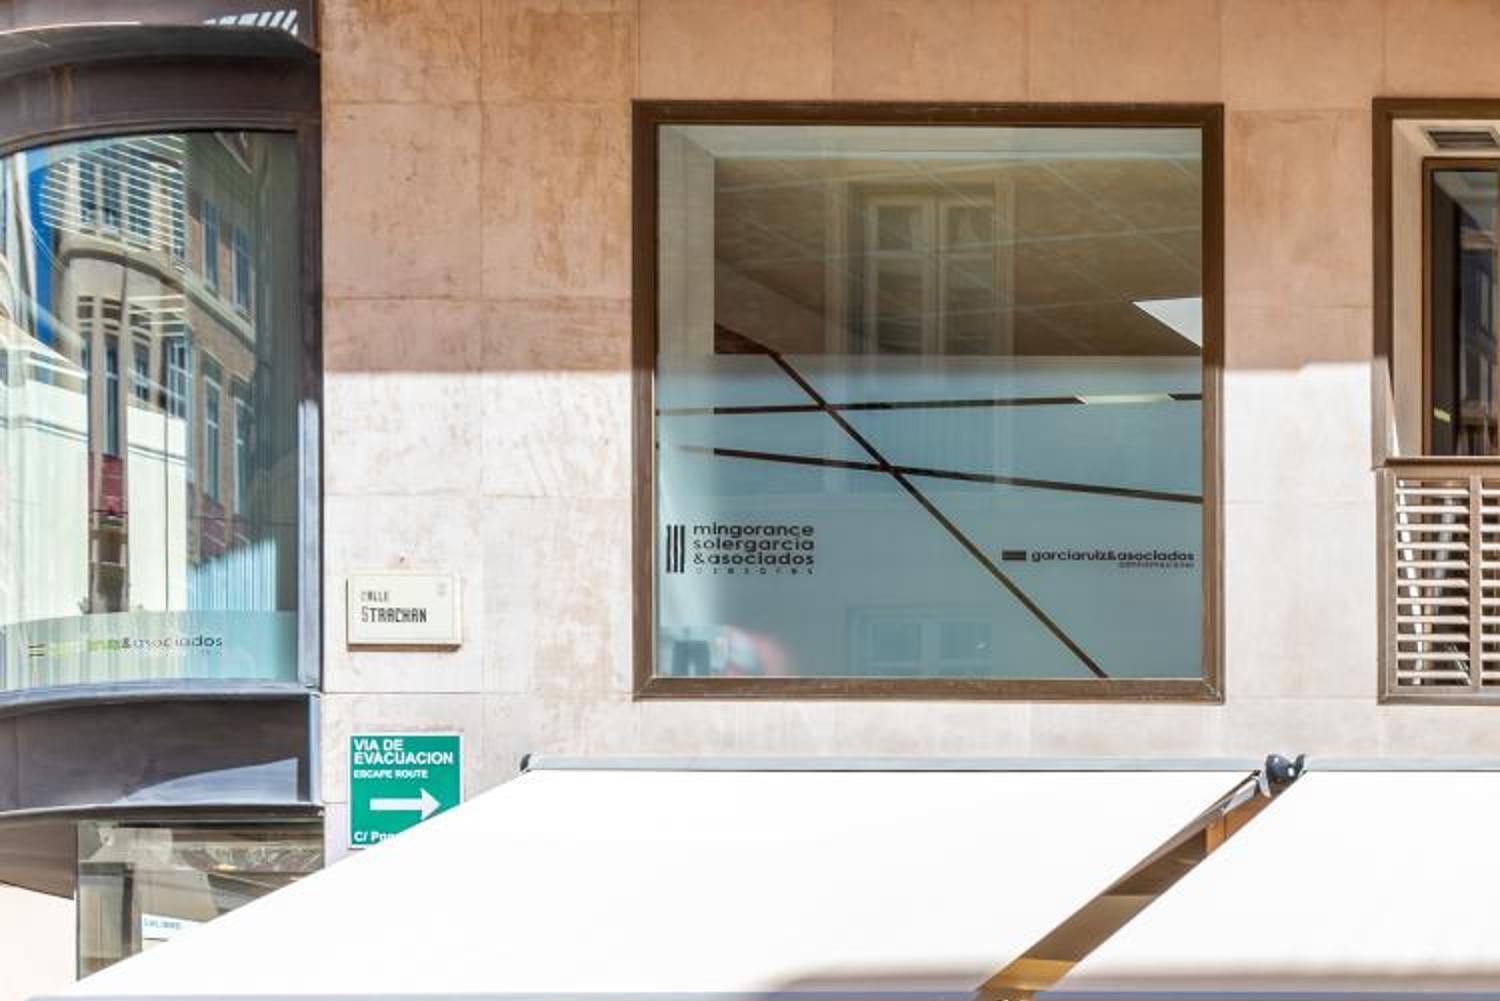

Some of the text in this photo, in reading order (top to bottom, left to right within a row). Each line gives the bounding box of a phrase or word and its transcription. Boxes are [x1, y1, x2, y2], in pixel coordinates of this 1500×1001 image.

[693, 523, 814, 538] mingorance
[693, 538, 815, 552] solergarcia
[708, 552, 814, 566] asociados
[361, 606, 428, 622] STRACHAN
[354, 739, 404, 750] VIA DE
[354, 752, 453, 764] EVACUACION
[354, 769, 428, 778] ESCAPE ROUTE
[354, 831, 368, 841] C/
